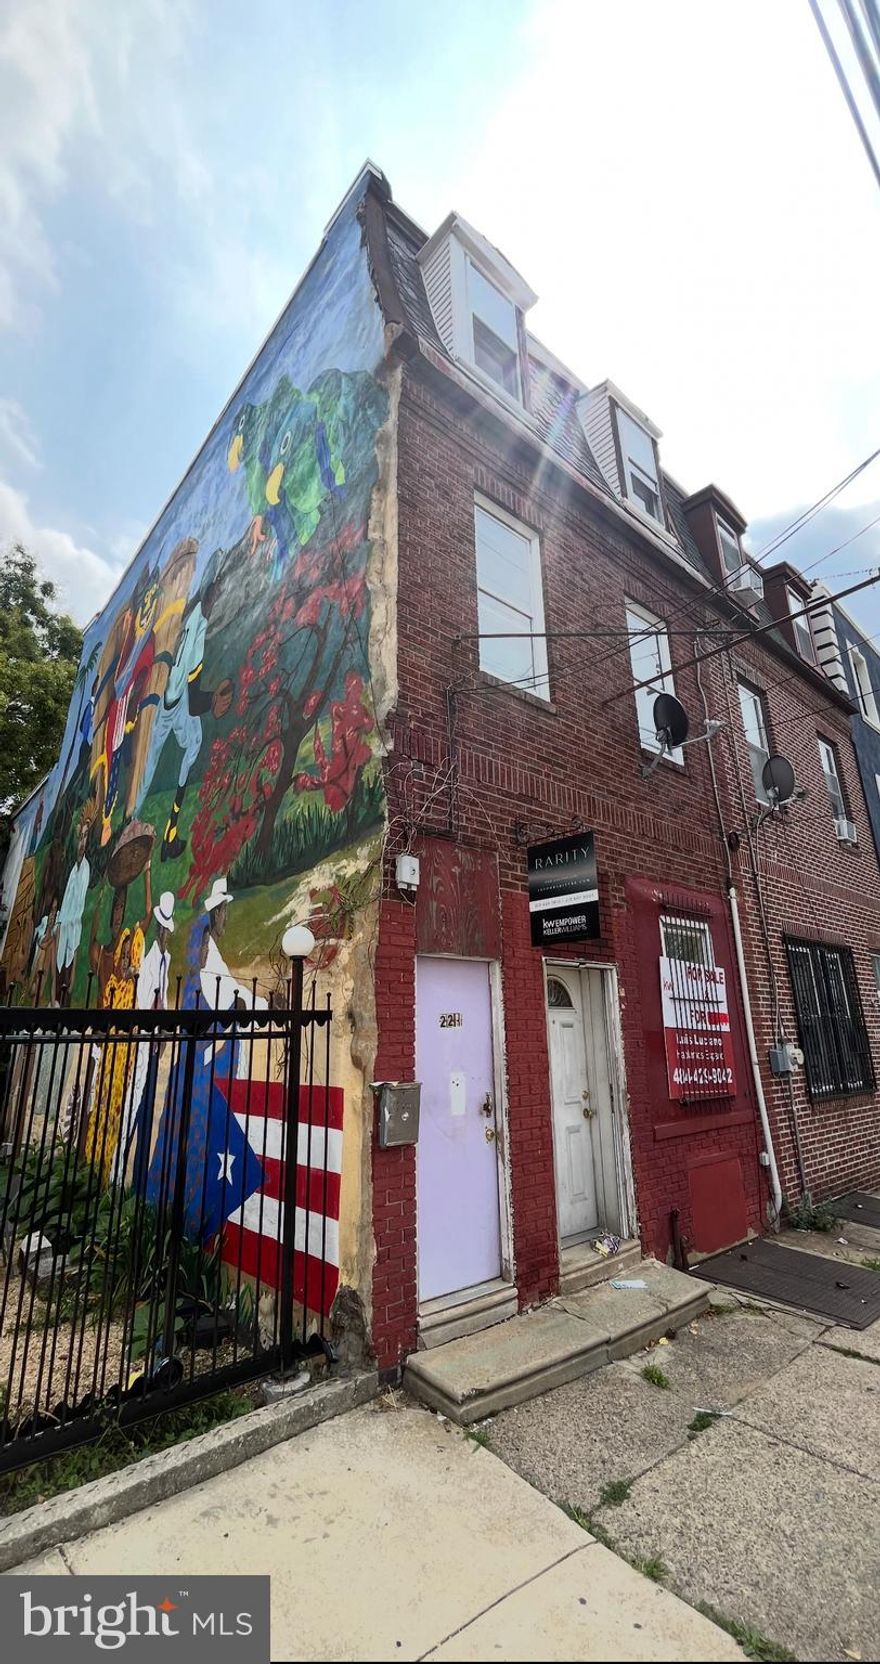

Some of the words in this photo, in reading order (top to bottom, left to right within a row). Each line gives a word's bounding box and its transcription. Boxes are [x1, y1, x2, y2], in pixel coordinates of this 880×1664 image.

[535, 846, 590, 870] RARITY
[687, 965, 702, 981] FOR
[705, 969, 724, 985] SALE
[690, 1009, 707, 1025] FOR
